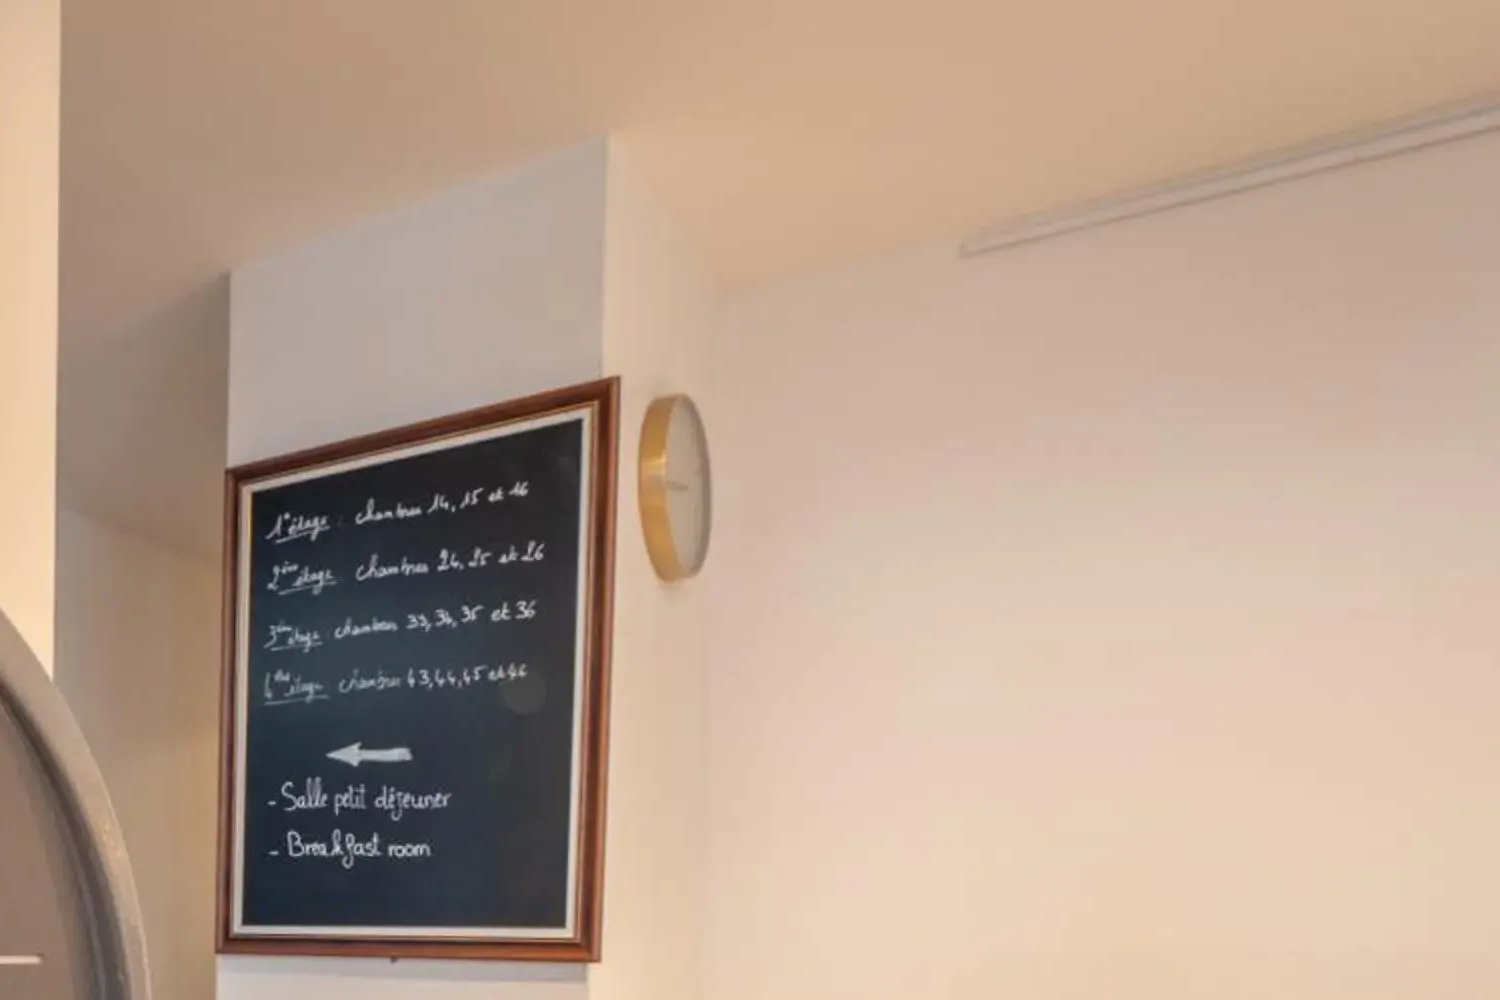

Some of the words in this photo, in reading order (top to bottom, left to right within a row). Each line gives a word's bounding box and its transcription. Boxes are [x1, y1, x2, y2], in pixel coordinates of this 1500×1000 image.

[488, 487, 504, 502] et
[498, 545, 518, 563] et
[521, 540, 546, 561] 26
[491, 602, 511, 622] et
[281, 776, 329, 811] Salle
[334, 783, 367, 816] petit
[373, 784, 452, 822] déjeuner
[287, 829, 383, 869] Breakfast
[388, 843, 432, 858] room
